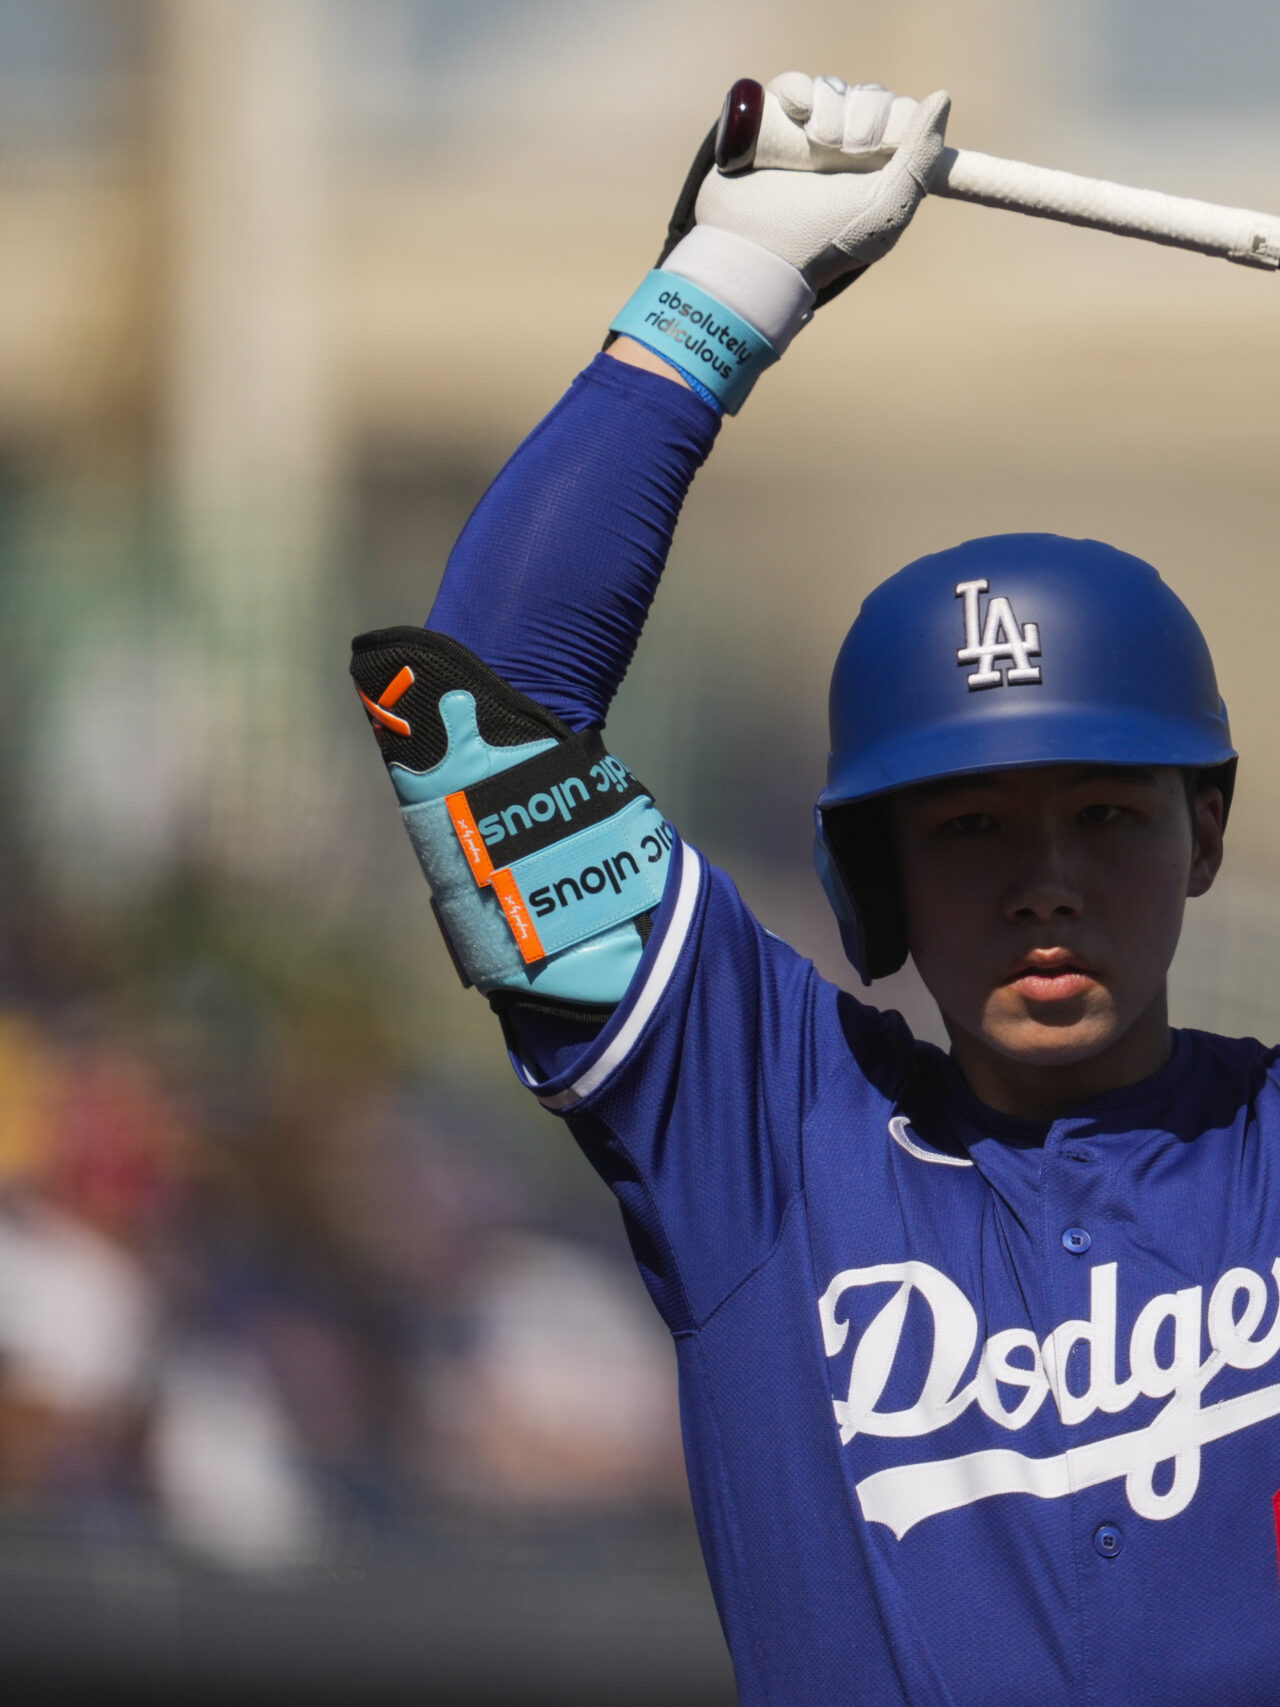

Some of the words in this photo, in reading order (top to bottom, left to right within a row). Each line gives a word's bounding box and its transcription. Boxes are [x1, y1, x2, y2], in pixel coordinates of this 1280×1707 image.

[645, 312, 733, 379] ridiculous
[659, 292, 752, 365] absolutely
[955, 578, 1041, 690] LA
[478, 777, 591, 846] ulous
[529, 851, 640, 917] ulous
